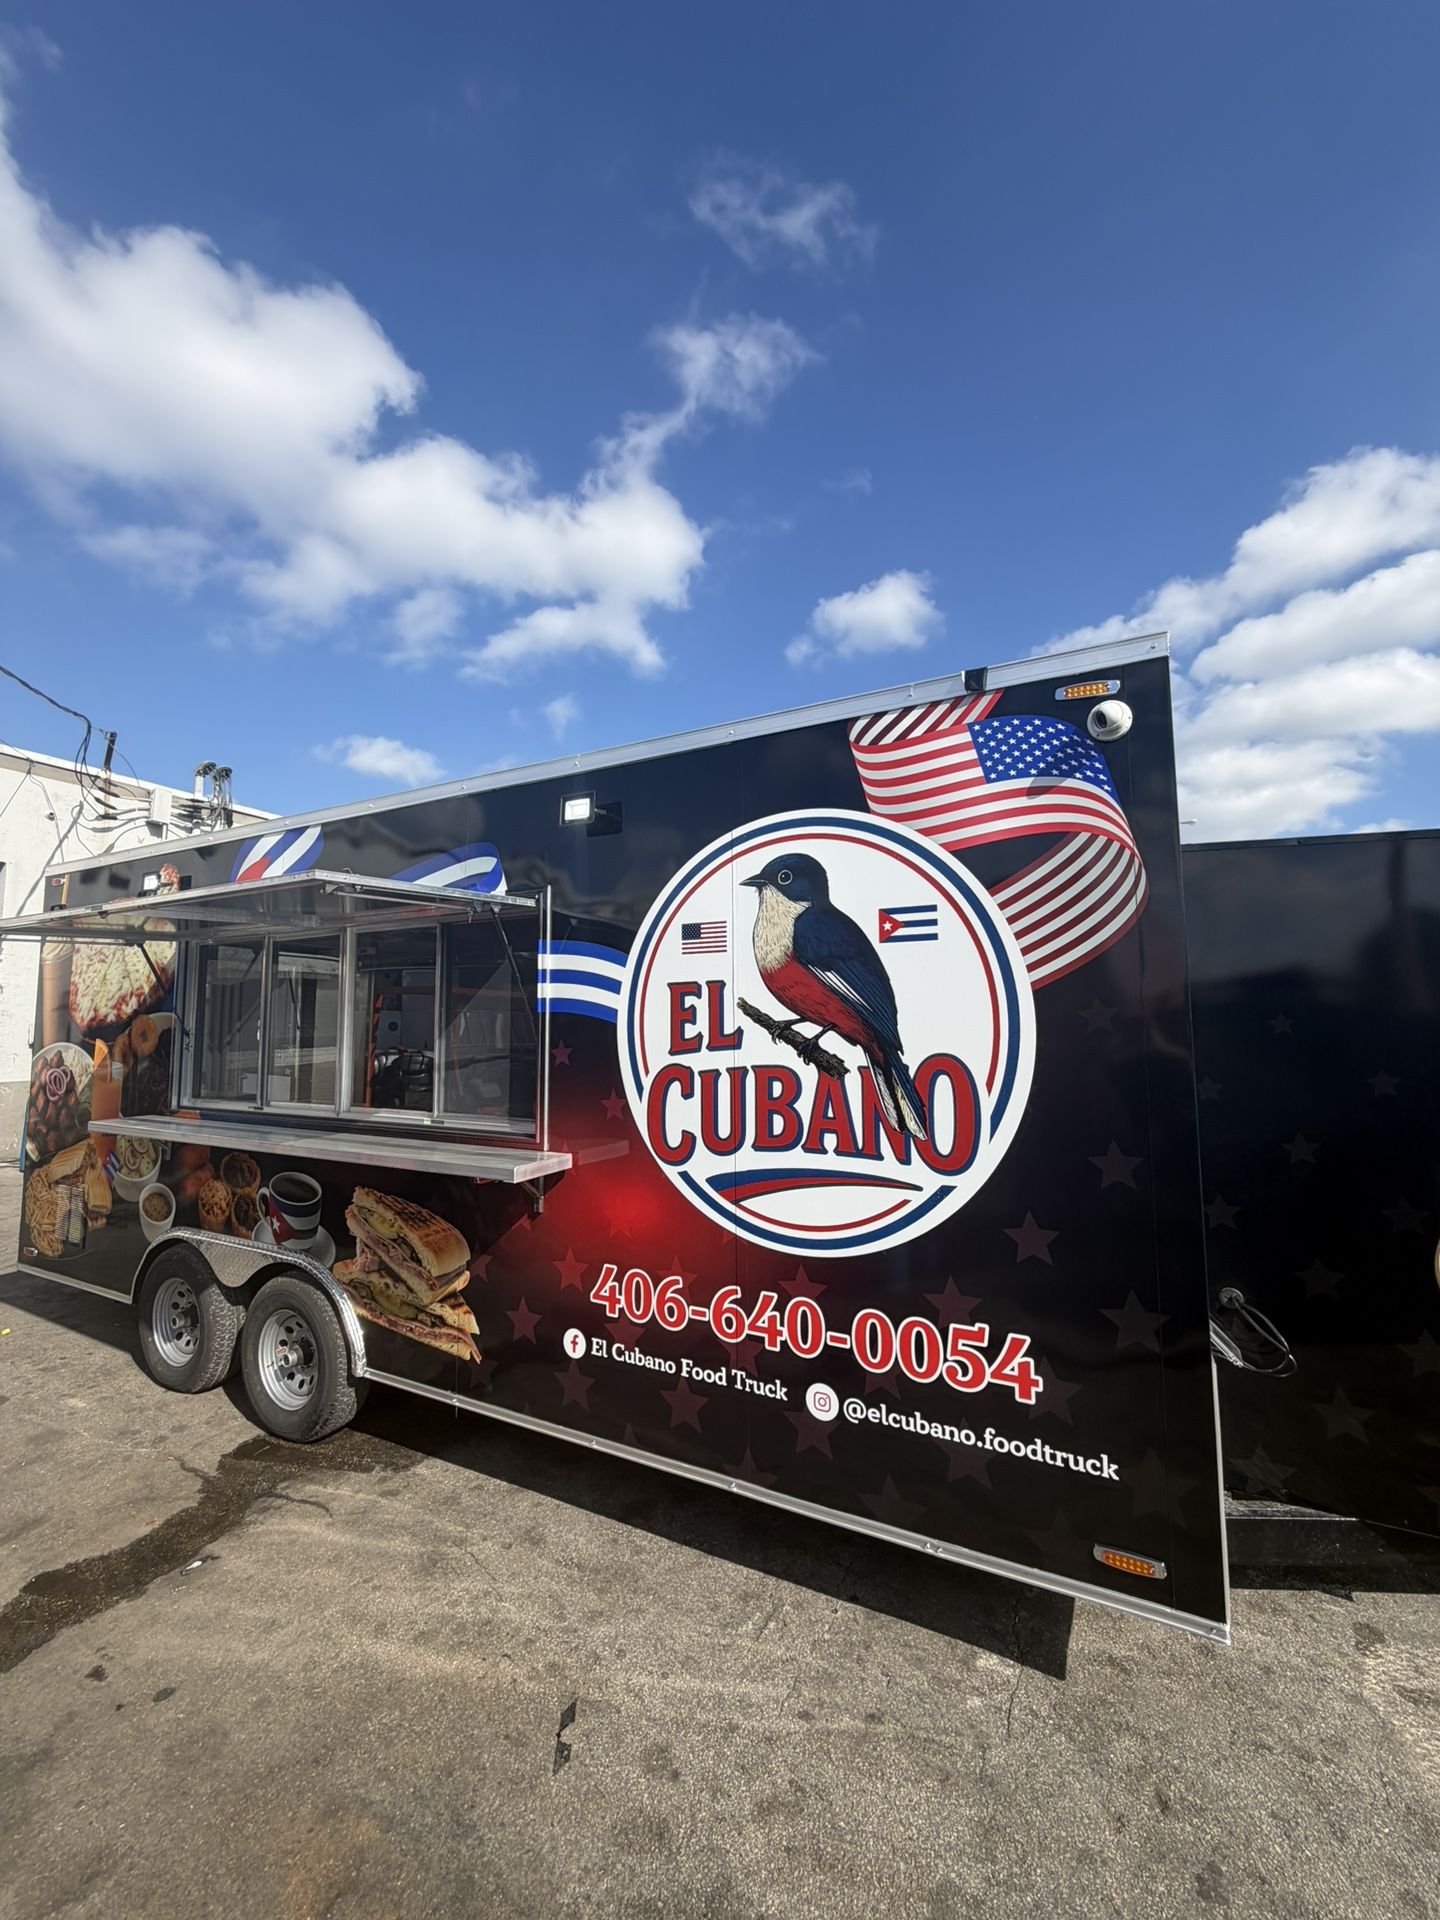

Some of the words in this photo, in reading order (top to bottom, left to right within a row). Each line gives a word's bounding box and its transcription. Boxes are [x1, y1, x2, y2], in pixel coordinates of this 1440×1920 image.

[667, 979, 744, 1057] EL
[590, 1263, 1043, 1405] 406-640-0054
[590, 1338, 608, 1358] El
[611, 1343, 676, 1375] Cubano
[681, 1358, 727, 1387] Food
[731, 1368, 788, 1401] Truck
[843, 1398, 1119, 1481] @elcubano.foodtruck
